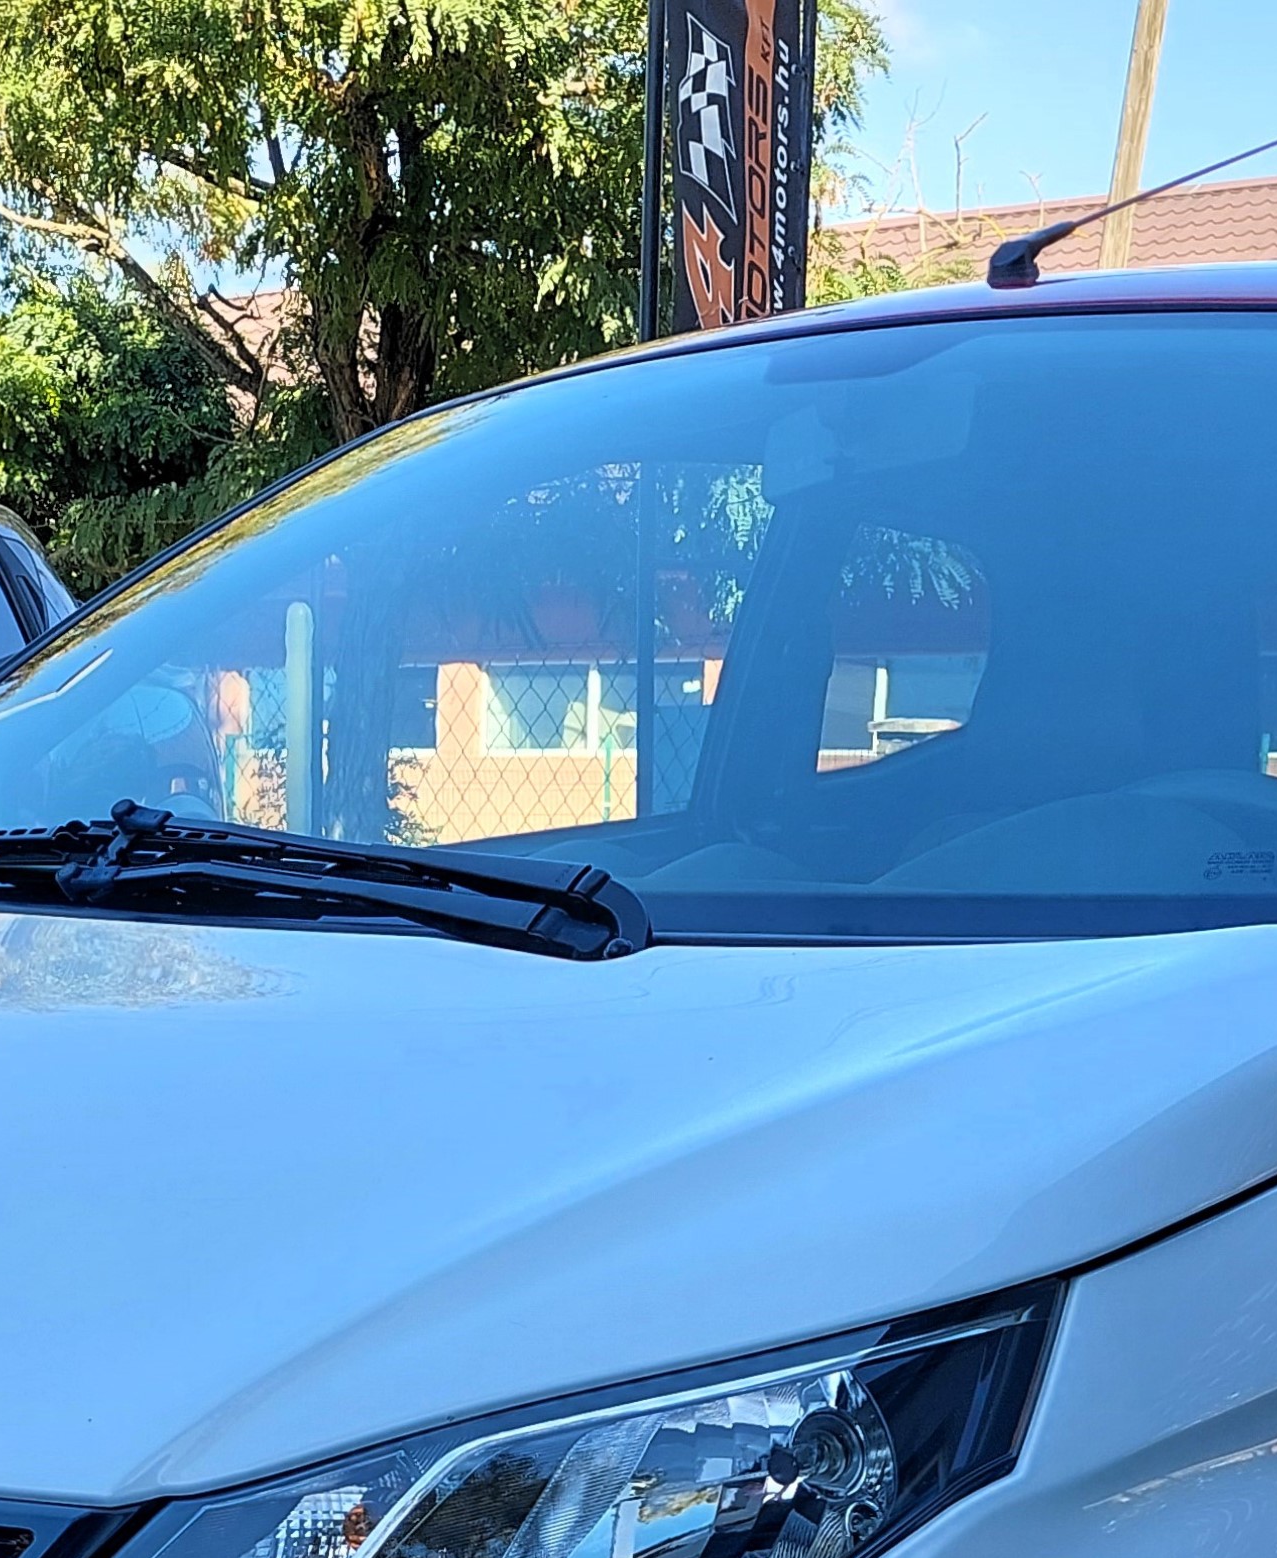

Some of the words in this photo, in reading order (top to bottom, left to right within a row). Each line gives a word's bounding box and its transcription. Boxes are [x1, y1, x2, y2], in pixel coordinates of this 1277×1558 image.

[682, 200, 734, 329] 4
[746, 65, 768, 319] OTORS
[760, 16, 771, 63] KFT
[772, 38, 790, 314] w.4motors.hu
